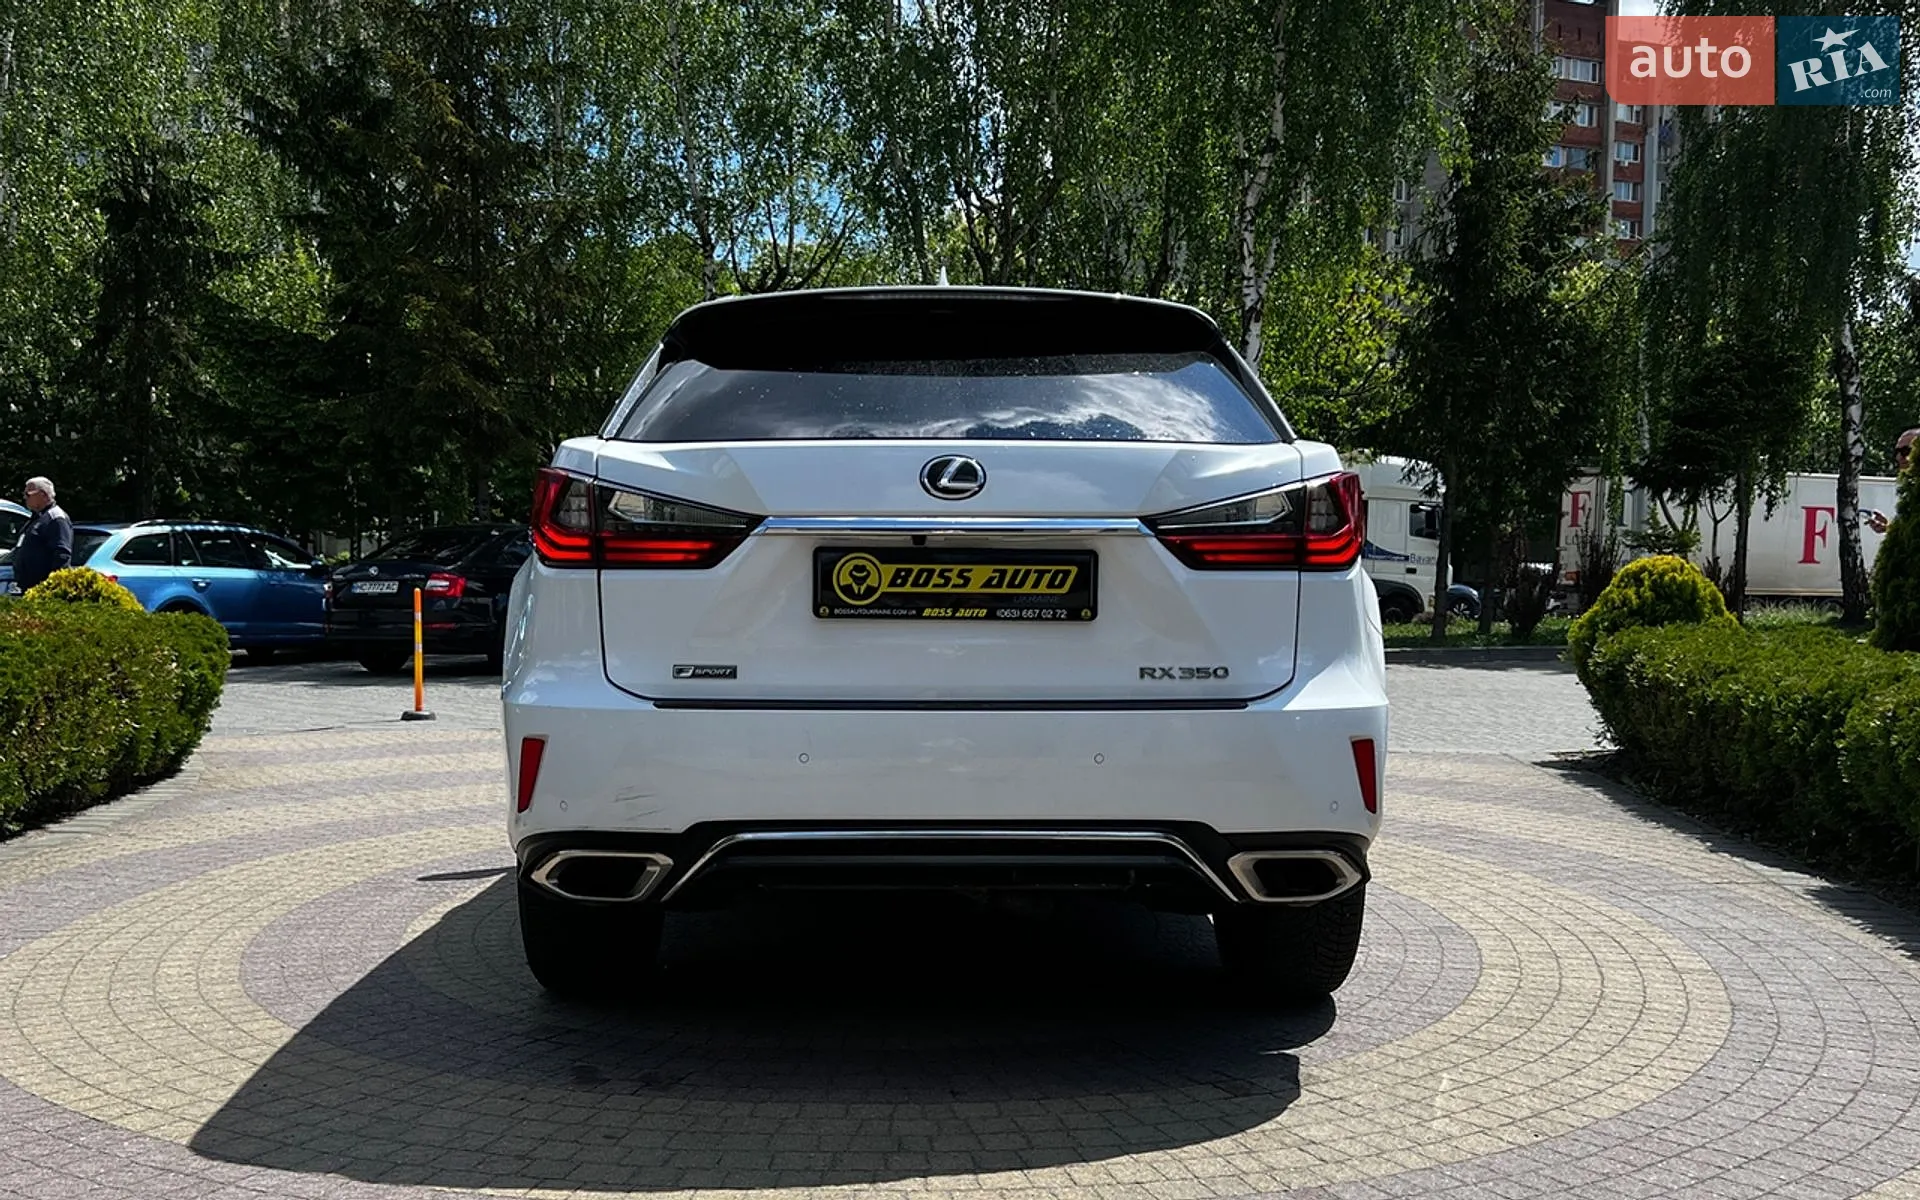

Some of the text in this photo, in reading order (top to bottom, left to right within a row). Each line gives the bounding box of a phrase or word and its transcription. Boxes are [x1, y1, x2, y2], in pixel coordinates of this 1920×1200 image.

[888, 567, 1073, 590] BOSS AUTO
[922, 608, 953, 617] BOSS
[955, 608, 988, 617] AUTO
[1055, 609, 1068, 618] 72
[695, 668, 733, 676] SPORT
